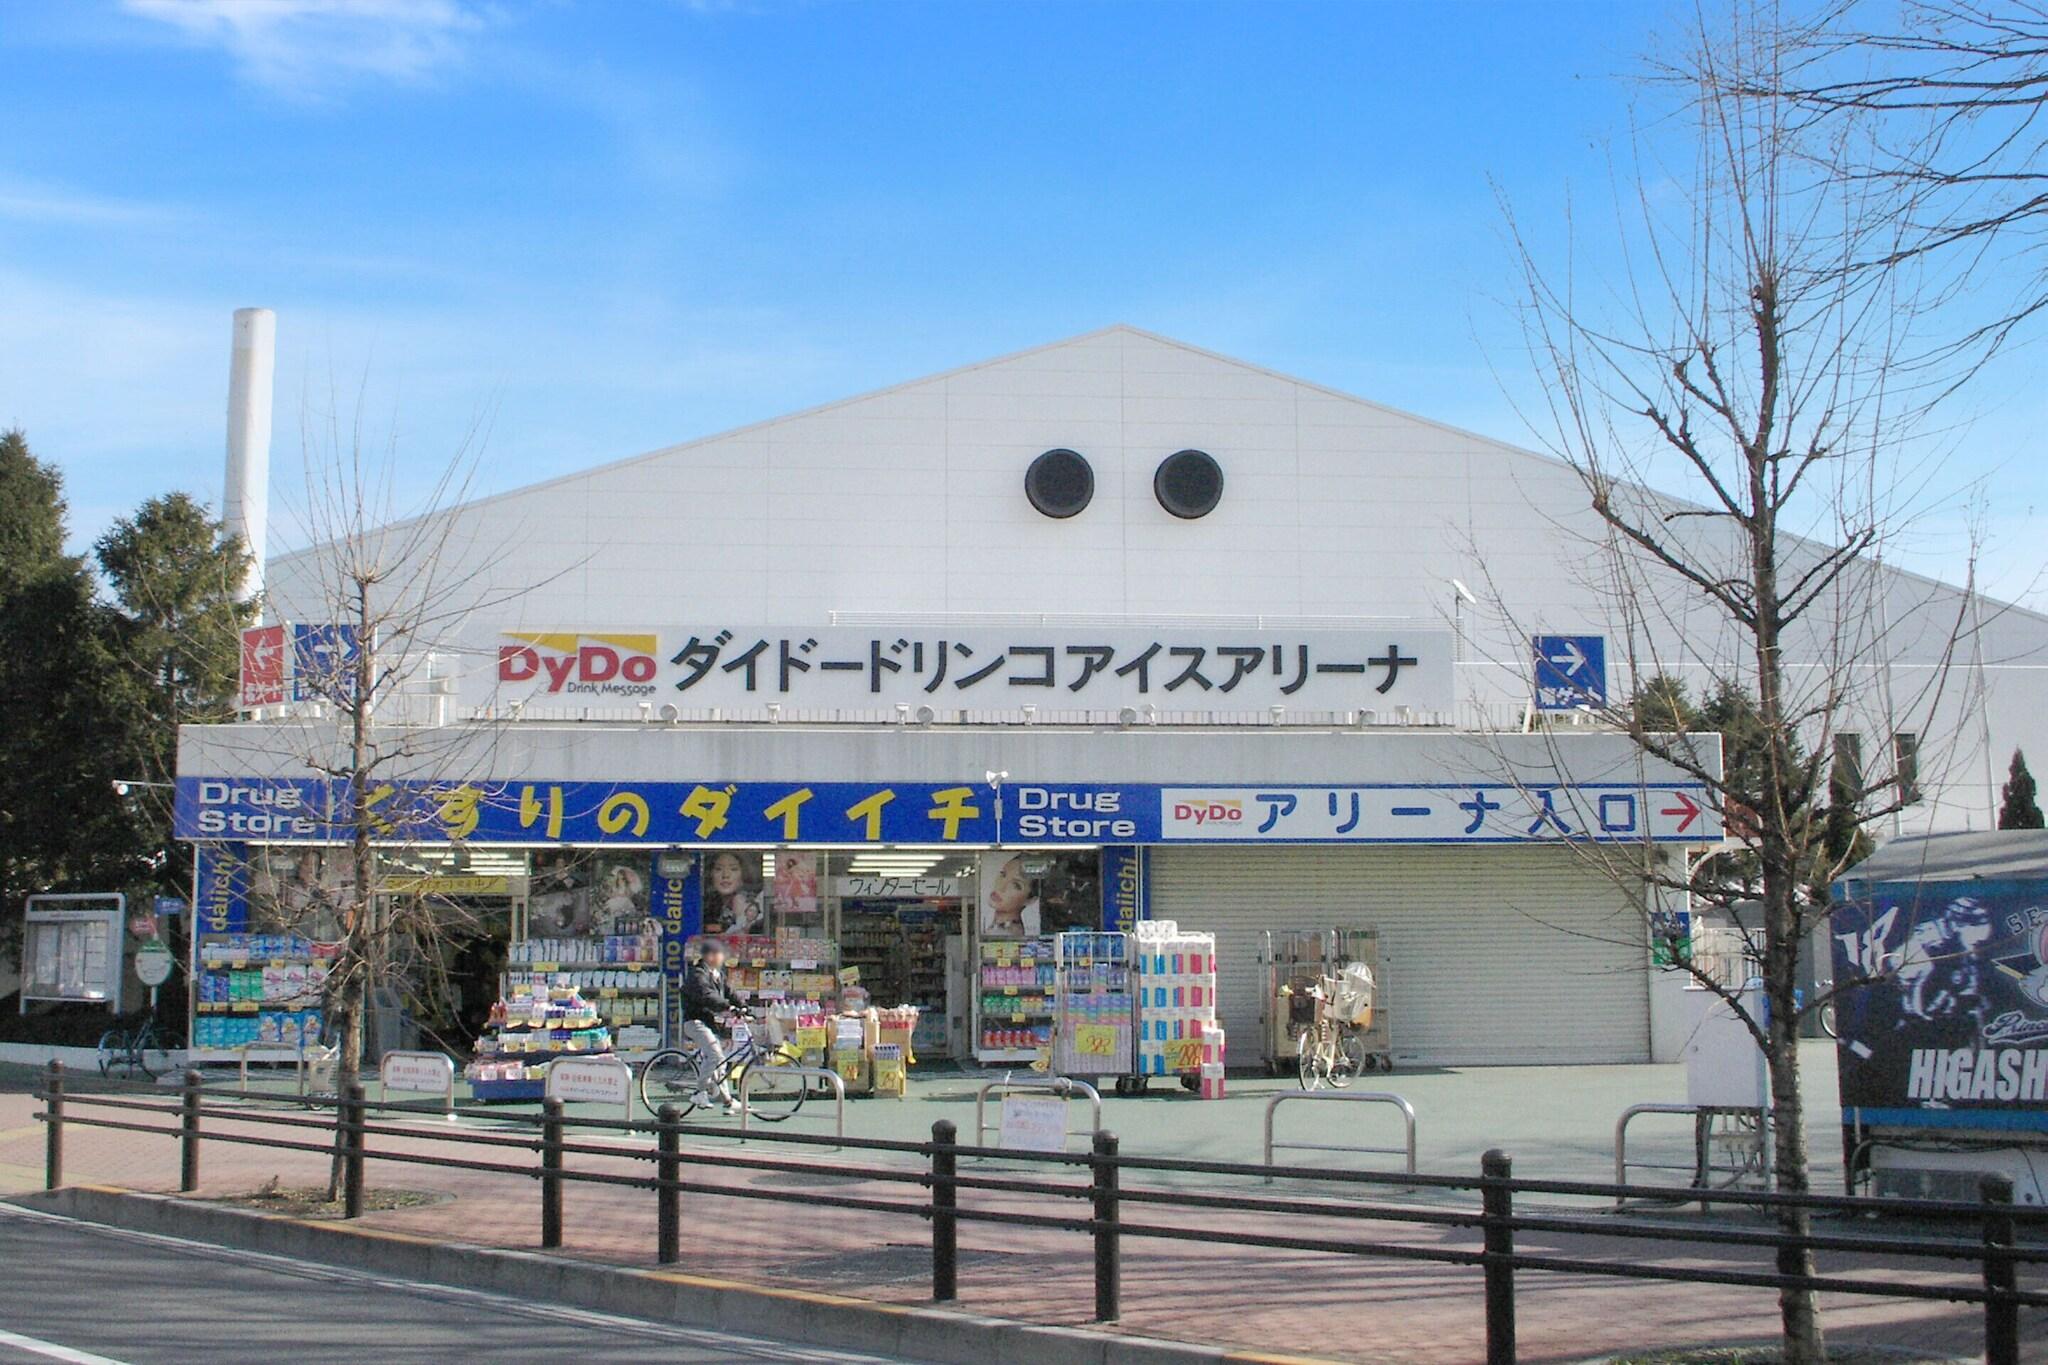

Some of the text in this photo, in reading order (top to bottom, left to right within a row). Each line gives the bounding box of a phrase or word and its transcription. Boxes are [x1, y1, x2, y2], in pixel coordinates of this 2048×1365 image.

[498, 645, 657, 693] DyDo
[670, 629, 1418, 695] ダイドードリンコアイスアリーナ
[567, 682, 657, 697] Drink Message
[199, 782, 303, 809] Drug
[1019, 787, 1121, 813] Drug
[199, 810, 316, 834] Store
[1174, 804, 1243, 825] DyDo
[1256, 791, 1636, 834] アリーナ入口
[1019, 815, 1136, 838] Store
[849, 877, 951, 896] ウィンターセール
[1114, 856, 1137, 935] daiichi
[663, 879, 683, 934] daiic
